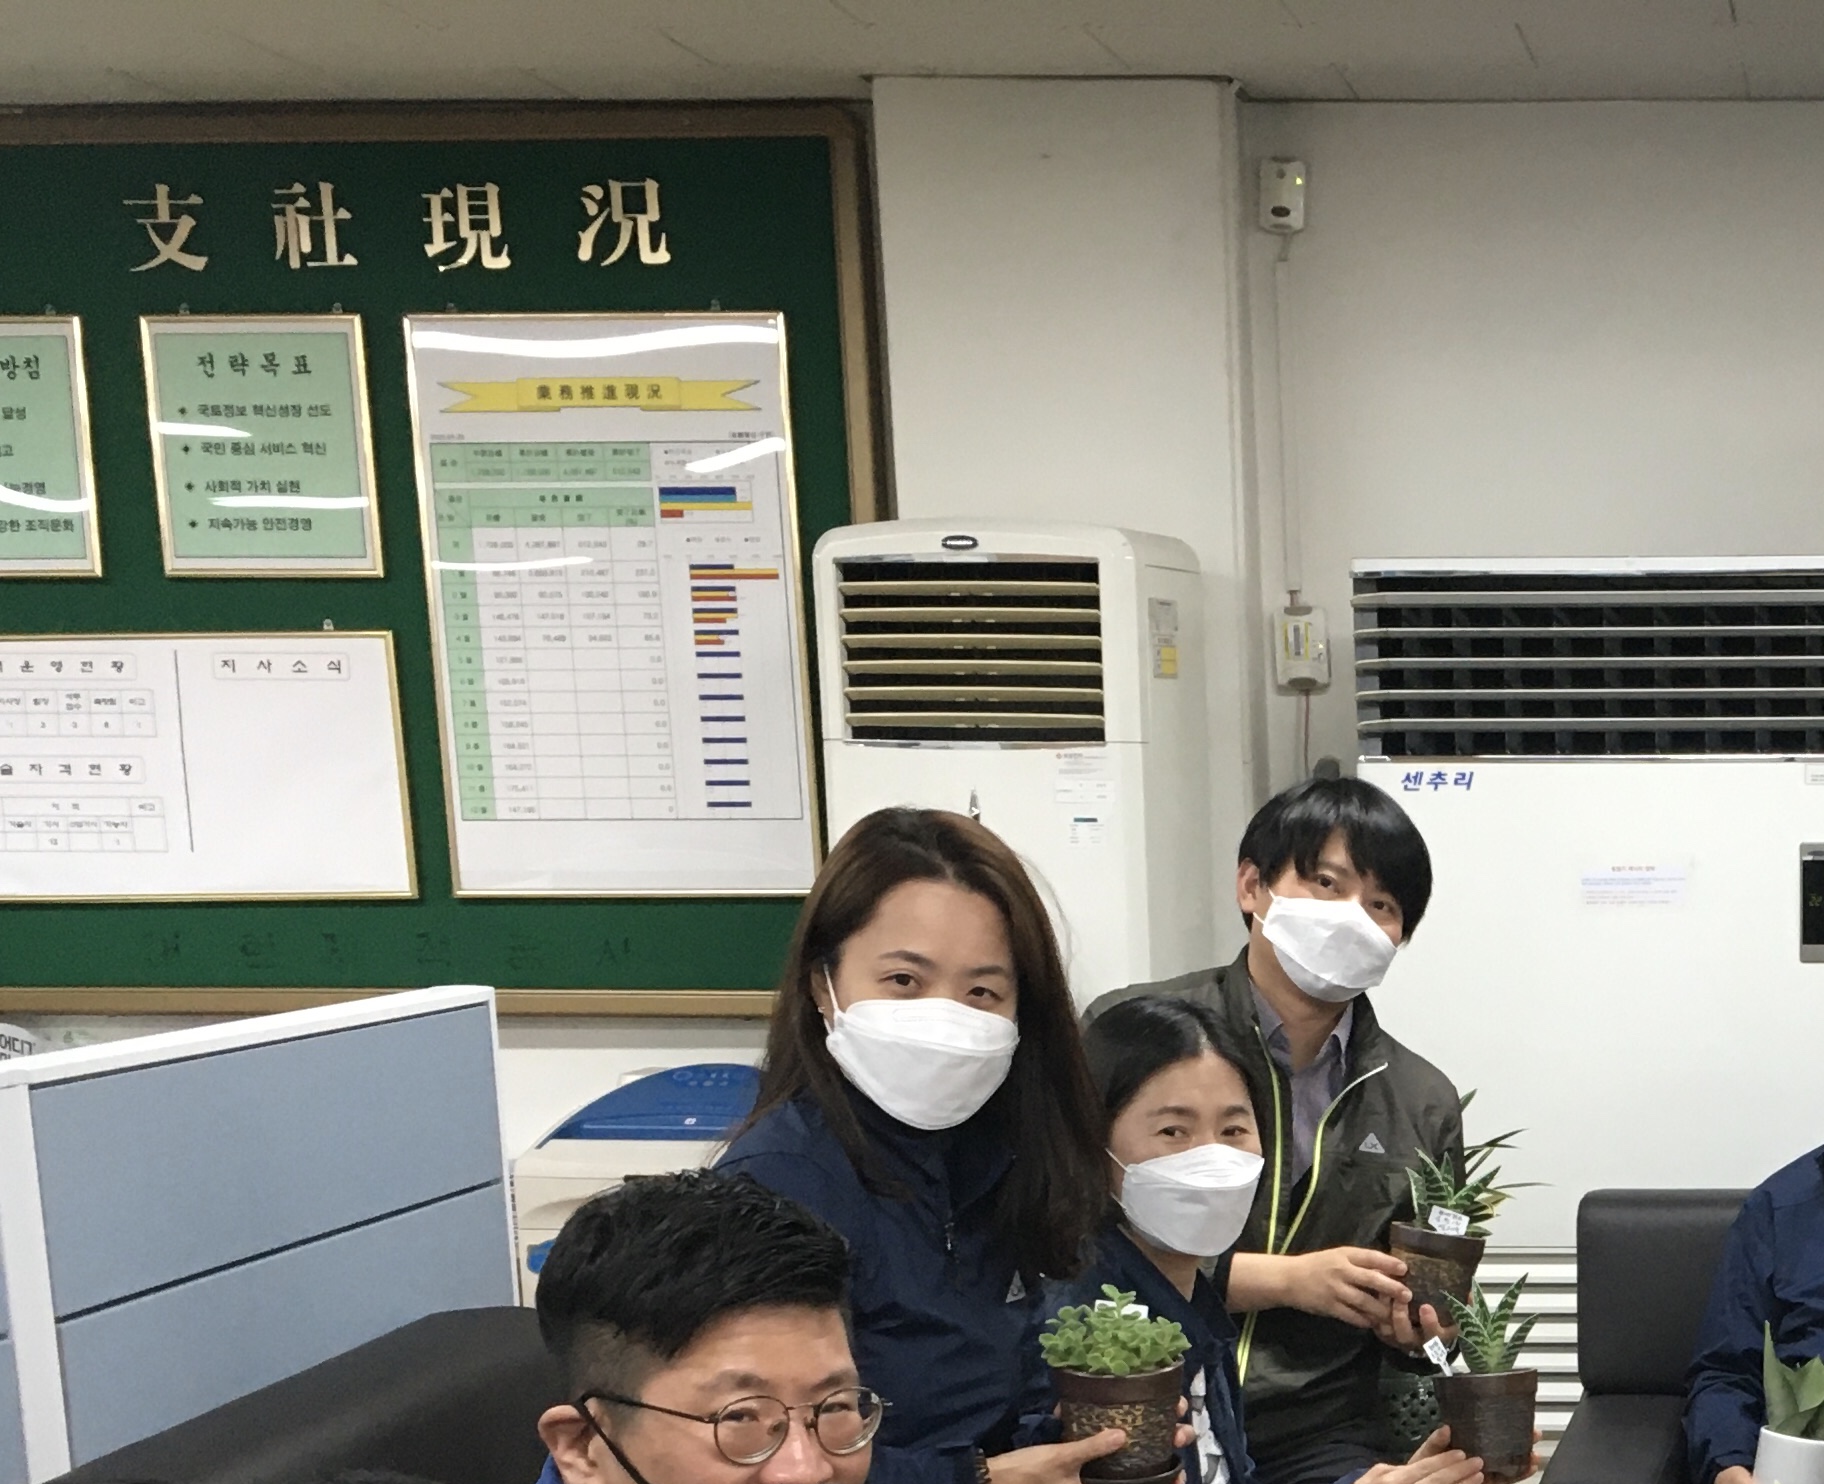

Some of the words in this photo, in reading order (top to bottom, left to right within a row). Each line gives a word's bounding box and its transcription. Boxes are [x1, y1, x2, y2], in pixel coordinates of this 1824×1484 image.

[123, 177, 672, 272] 支社現況
[0, 354, 41, 380] 방침
[306, 404, 332, 418] 선도
[0, 445, 15, 458] 고
[259, 442, 298, 456] 서비스
[300, 442, 327, 456] 혁신
[205, 480, 242, 493] 사회적
[246, 480, 272, 493] 가치
[275, 480, 301, 494] 실현
[25, 519, 75, 533] 조직문화
[208, 518, 258, 532] 지속가능
[262, 518, 313, 532] 안전경영
[220, 658, 342, 675] 지사소식
[1401, 771, 1475, 792] 센추리
